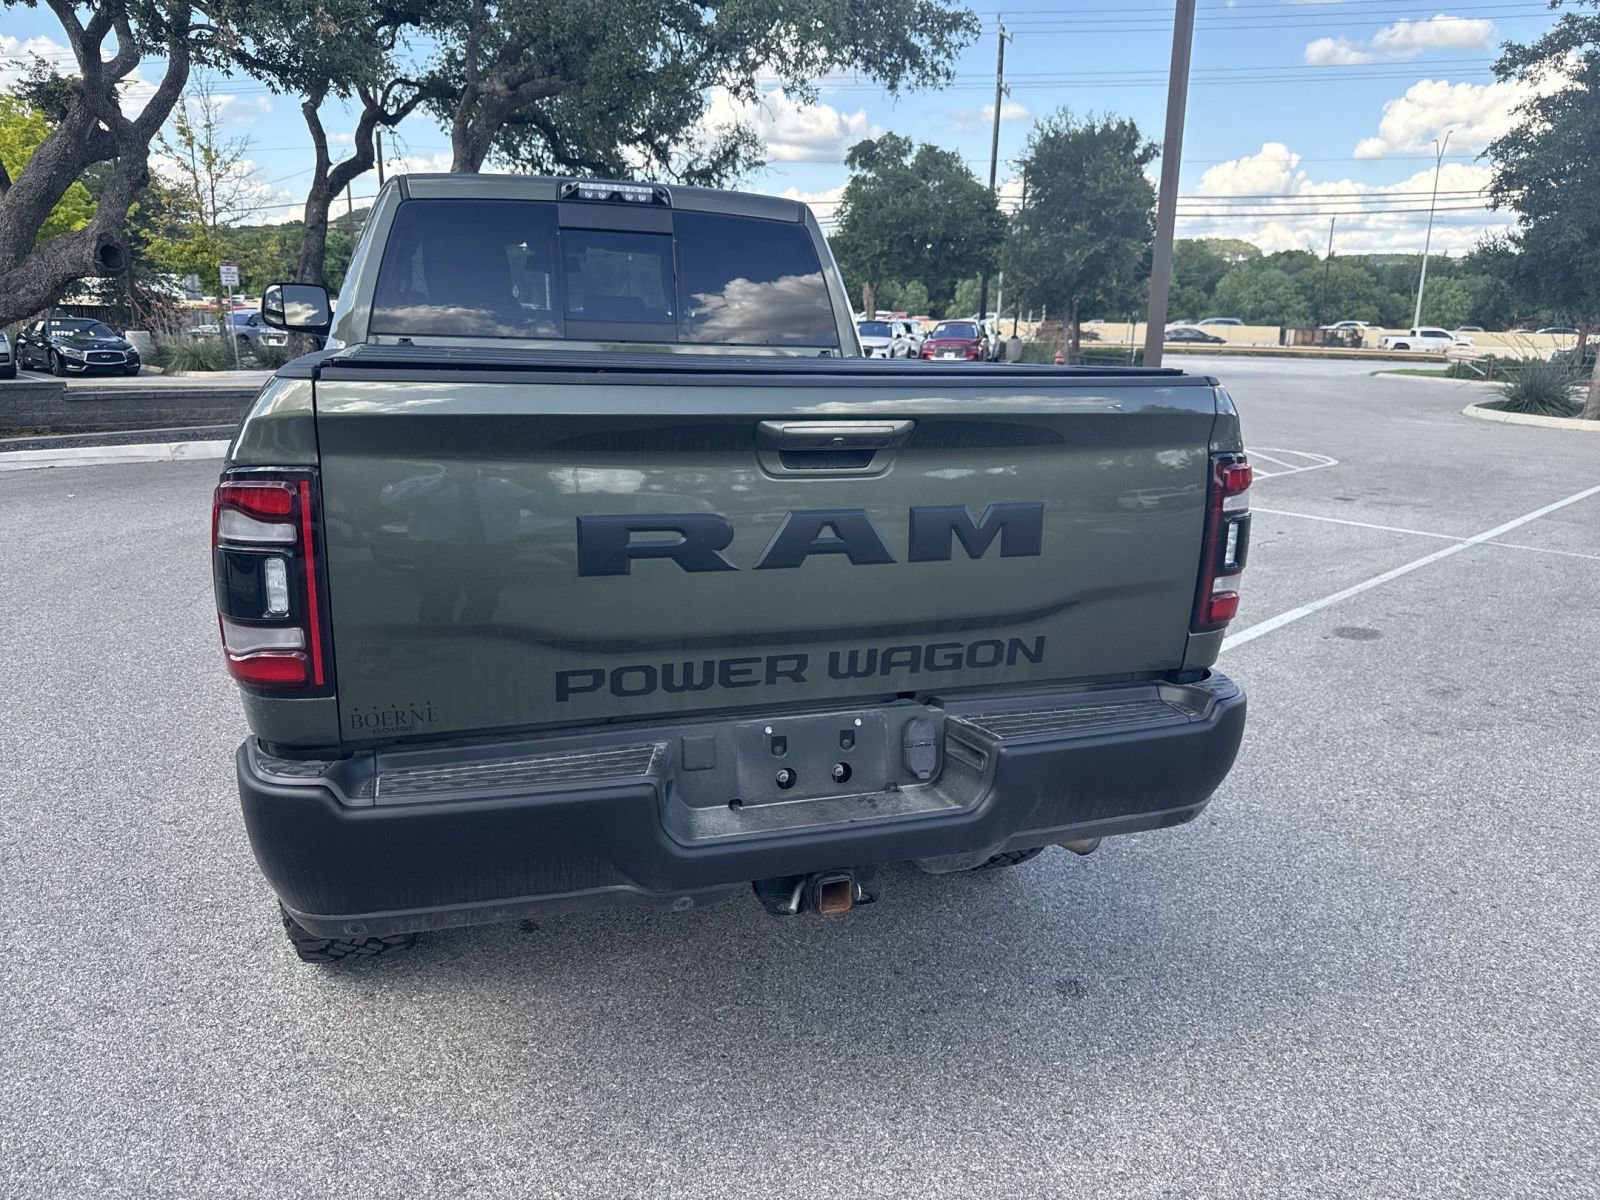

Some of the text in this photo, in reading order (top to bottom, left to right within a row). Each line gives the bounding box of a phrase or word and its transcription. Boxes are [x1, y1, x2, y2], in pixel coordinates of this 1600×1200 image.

[576, 502, 1044, 576] RAM
[556, 636, 1045, 702] POWER WAGON
[351, 706, 439, 729] BOERNE
